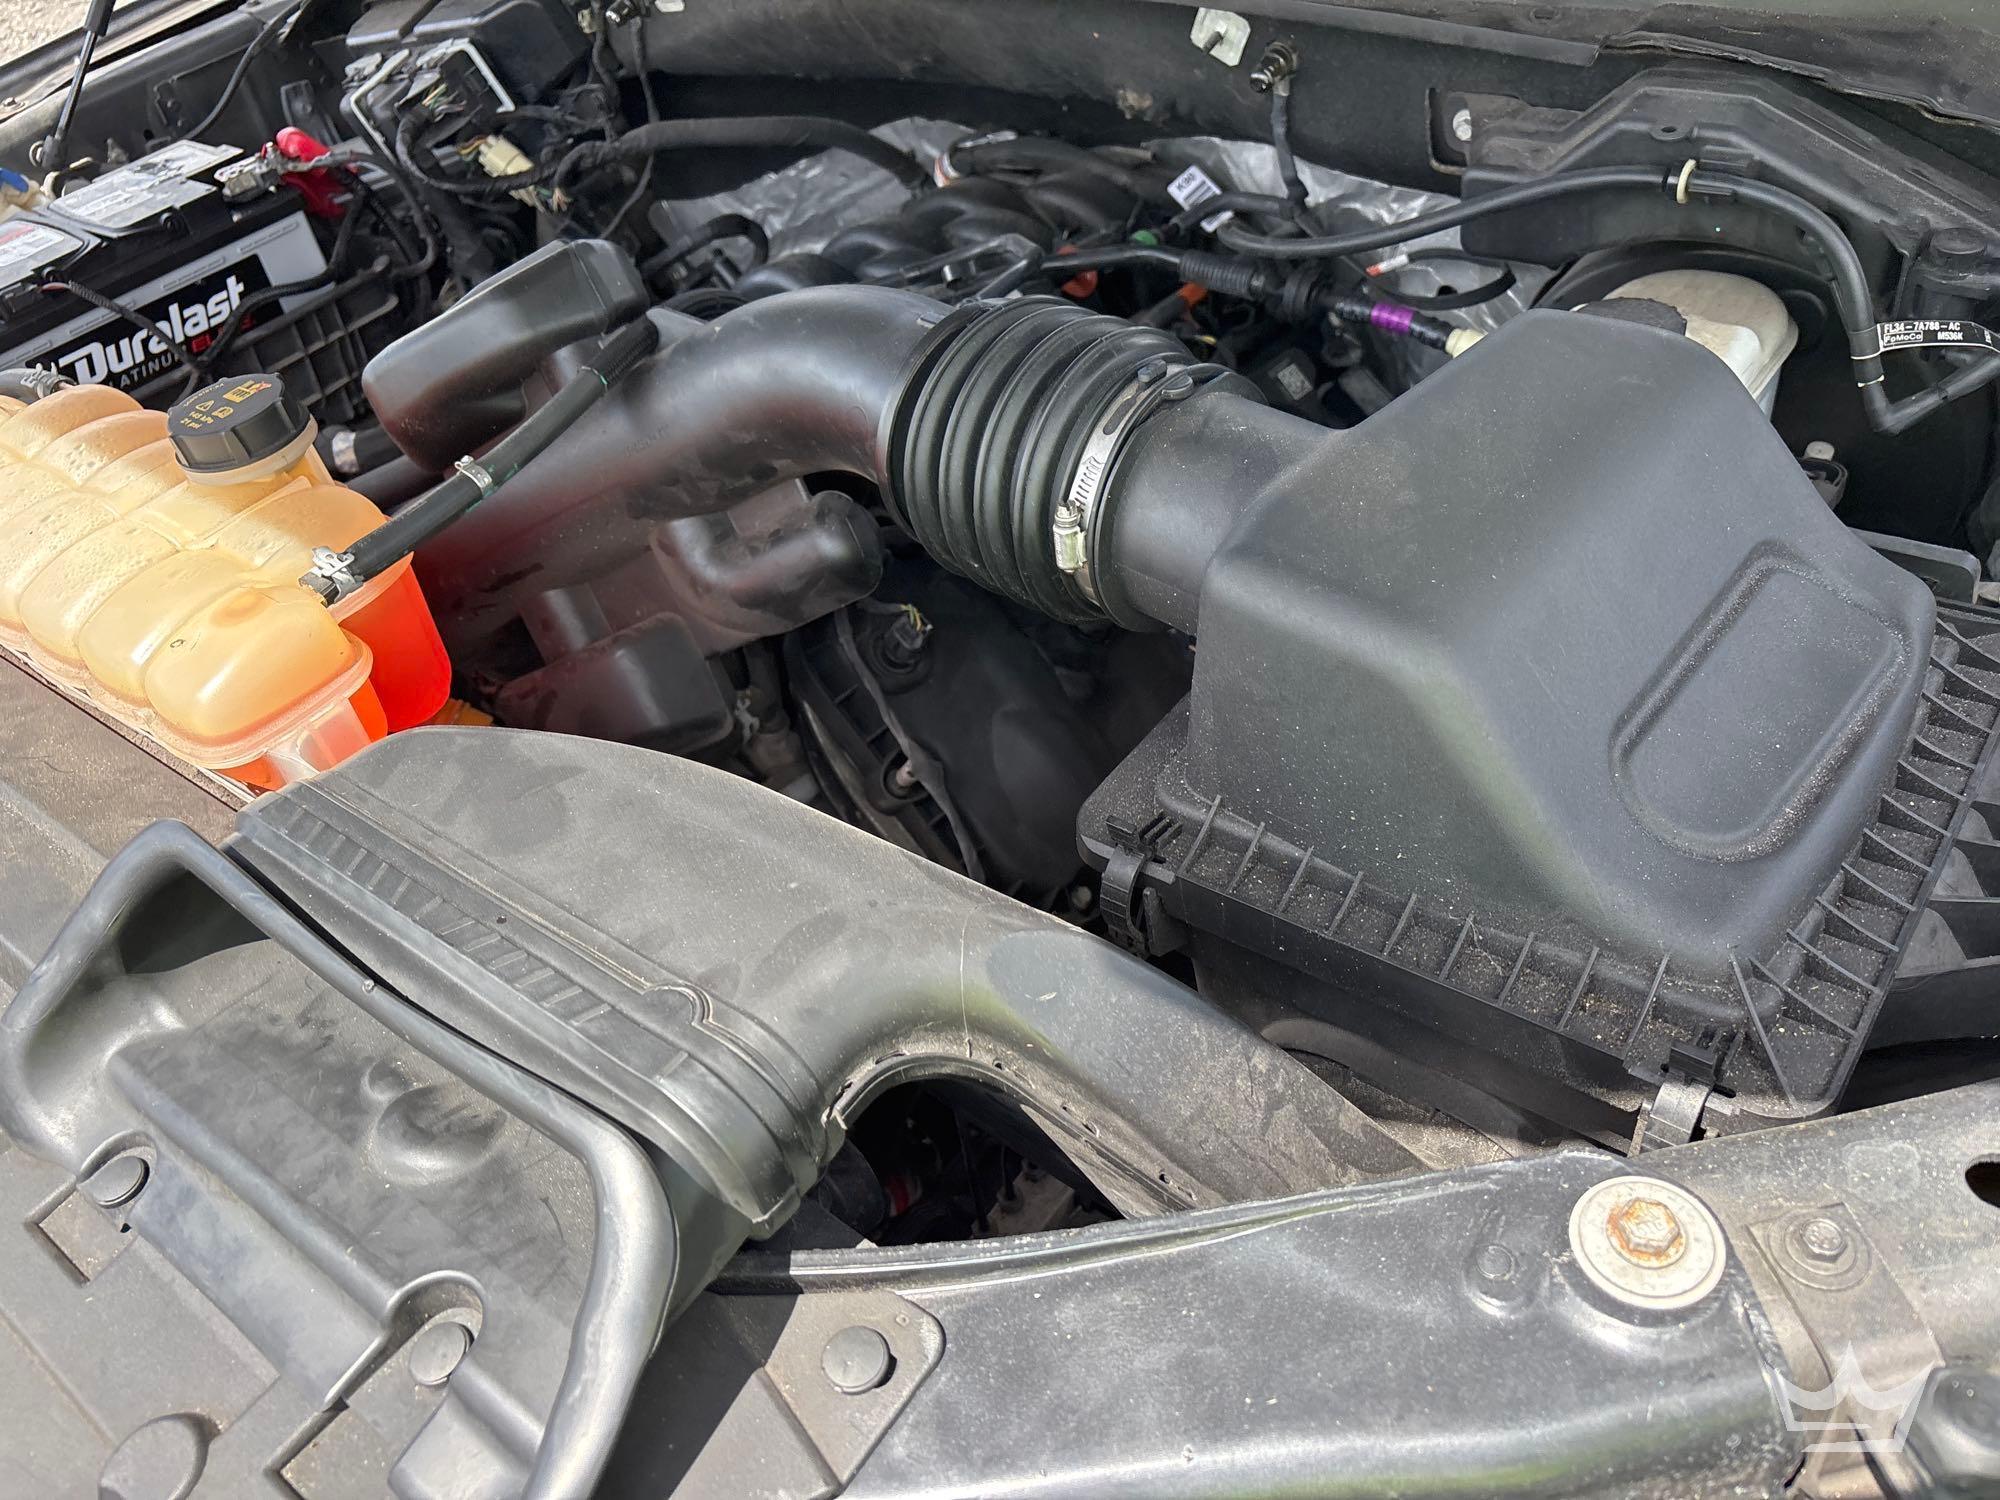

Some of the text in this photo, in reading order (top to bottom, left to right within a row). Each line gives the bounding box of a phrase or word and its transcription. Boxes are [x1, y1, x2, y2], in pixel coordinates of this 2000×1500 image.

[58, 274, 245, 385] Duralast
[1885, 333, 1922, 343] FoMoCo
[108, 344, 187, 389] ATINU
